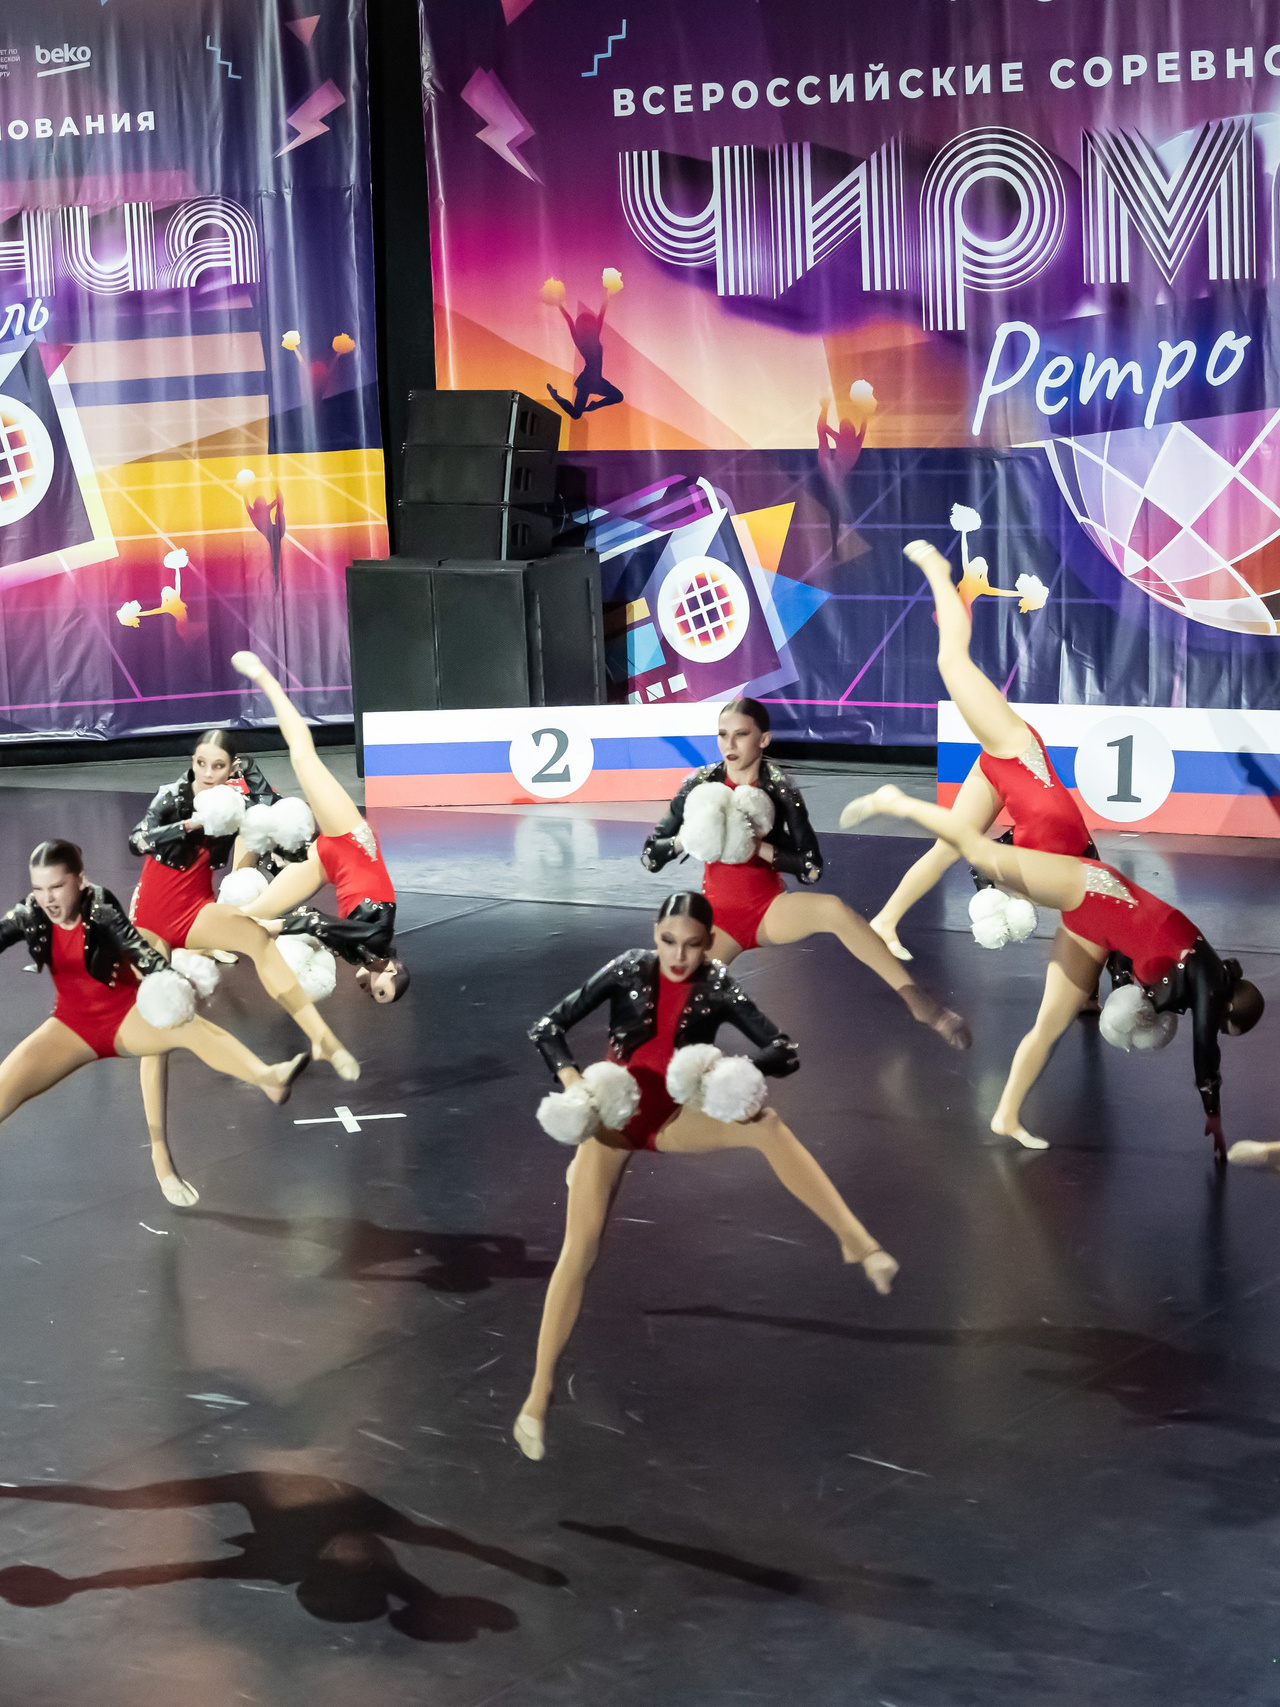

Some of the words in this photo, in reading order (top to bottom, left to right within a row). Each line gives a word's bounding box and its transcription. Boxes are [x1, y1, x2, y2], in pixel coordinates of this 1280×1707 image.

[35, 43, 91, 65] beko
[613, 63, 1024, 117] ВСЕРОССИЙСКИЕ
[618, 118, 1280, 332] ЧИРМ
[972, 320, 1251, 437] Ретро
[531, 728, 571, 783] 2
[1106, 734, 1142, 803] 1
